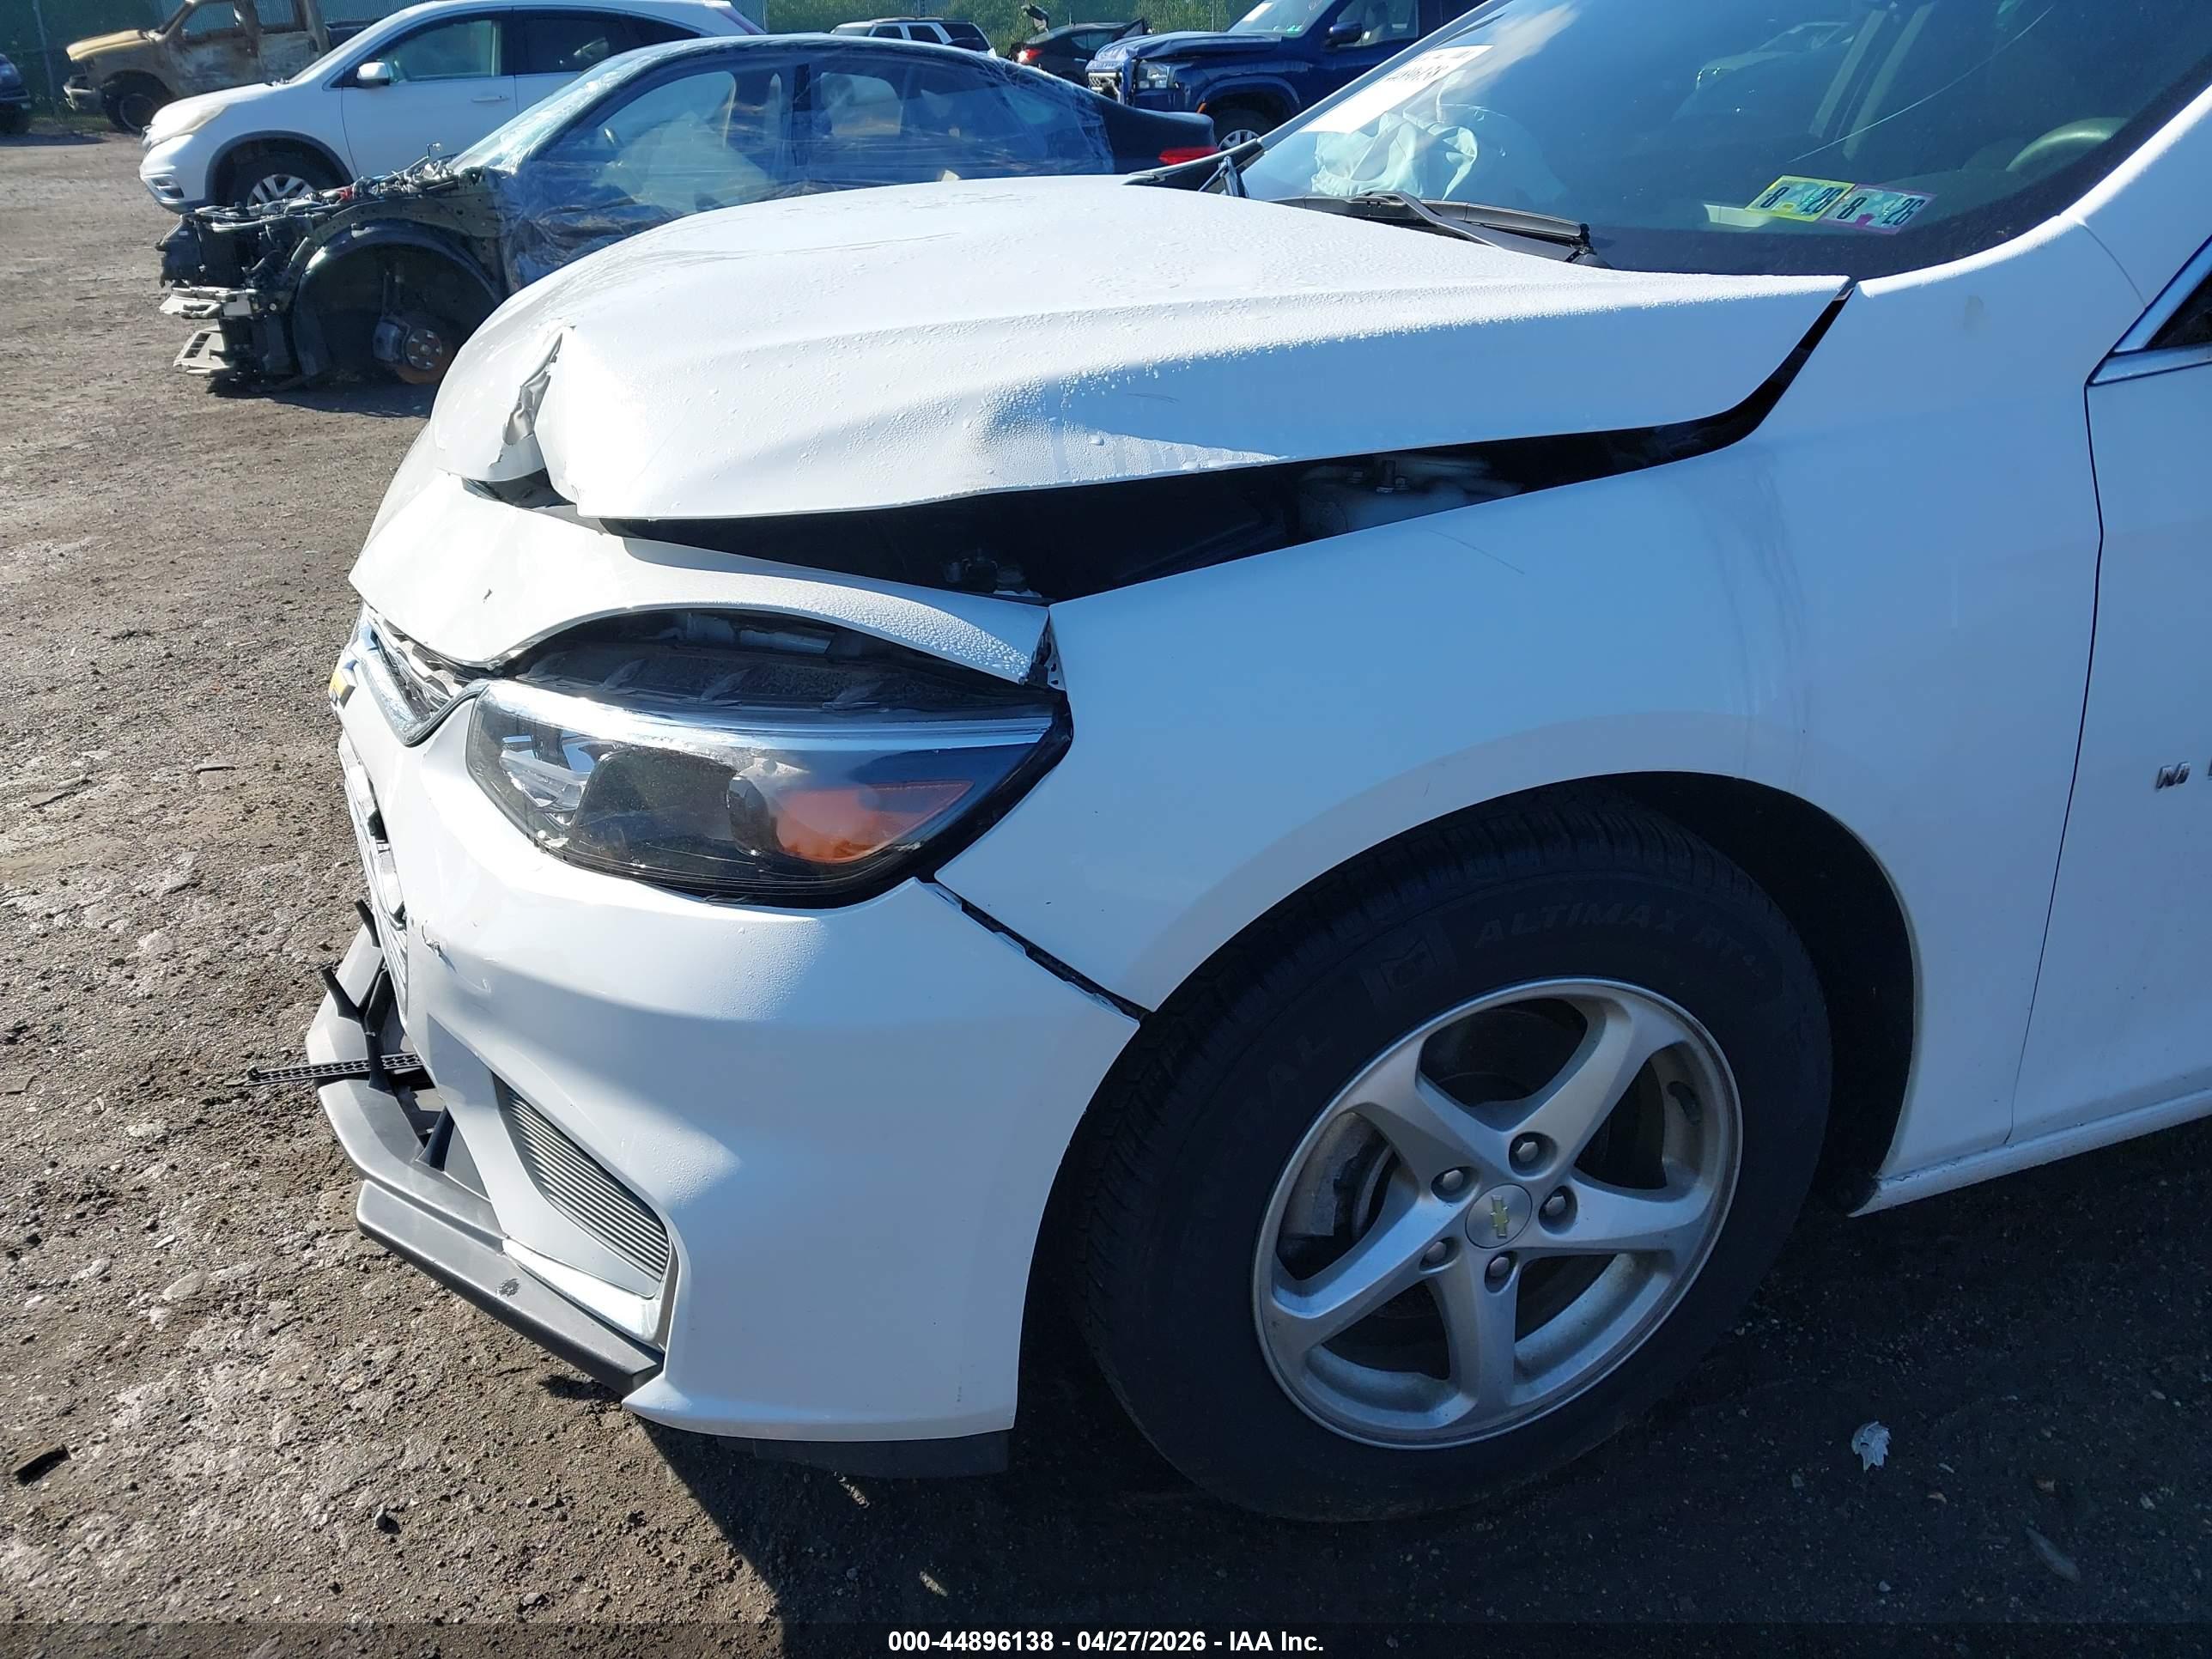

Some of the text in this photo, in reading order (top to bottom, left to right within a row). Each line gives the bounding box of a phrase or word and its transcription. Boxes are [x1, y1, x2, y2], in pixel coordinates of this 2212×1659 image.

[1760, 186, 1790, 208] 8
[1837, 197, 1925, 226] 8 26
[1474, 902, 1685, 949] ALTIMAX
